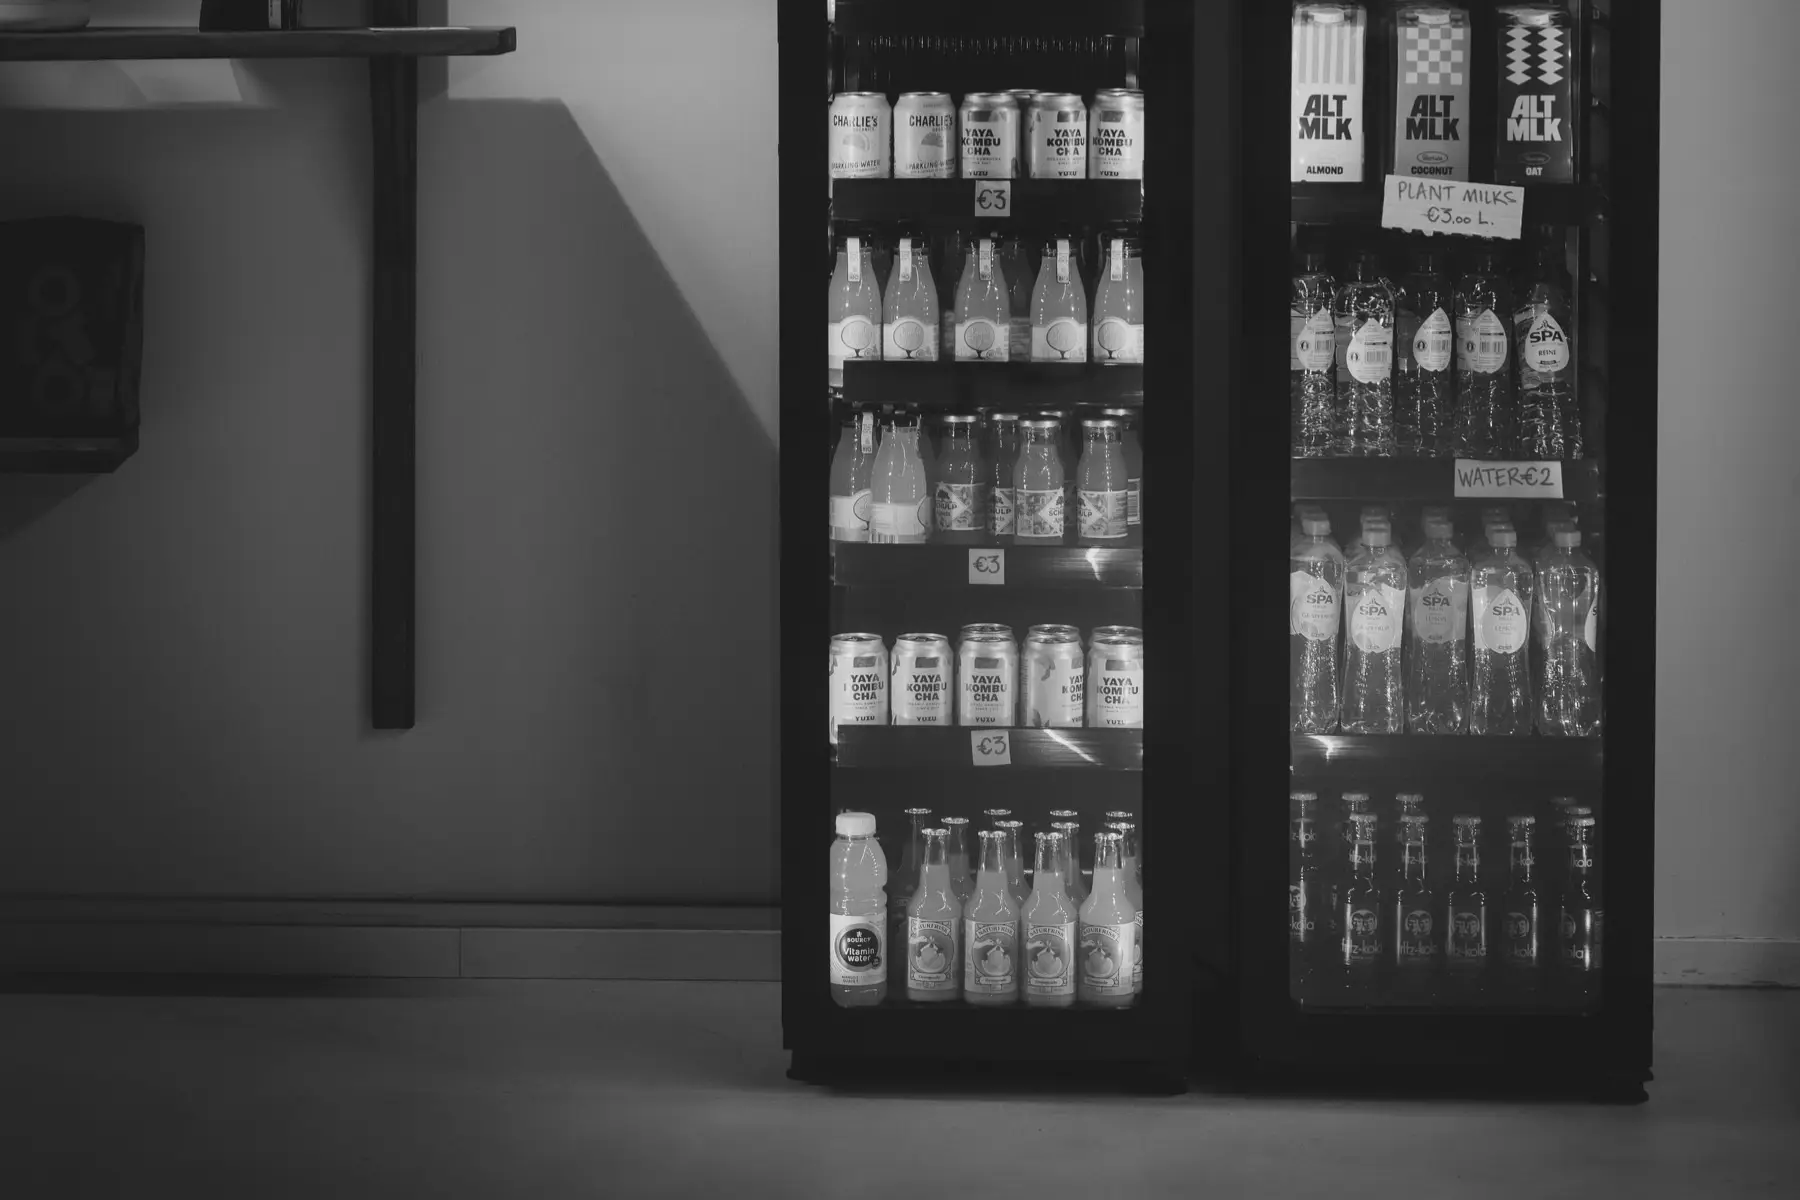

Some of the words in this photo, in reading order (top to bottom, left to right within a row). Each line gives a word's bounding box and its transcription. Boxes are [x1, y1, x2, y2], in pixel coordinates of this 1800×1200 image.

[1303, 94, 1347, 117] ALT
[1409, 94, 1454, 117] ALT
[1510, 94, 1556, 118] ALT
[965, 128, 994, 138] YAYA
[1053, 128, 1082, 138] YAYA
[1096, 128, 1125, 138] YAYA
[1299, 117, 1352, 140] MLK
[1405, 117, 1460, 141] MLK
[1506, 117, 1562, 142] MLK
[961, 138, 1001, 147] KOMBU
[1092, 138, 1133, 147] KOMBU
[967, 148, 991, 156] CHA
[1098, 148, 1123, 157] CHA
[1306, 165, 1344, 176] ALMOND
[1410, 165, 1454, 176] COCONUT
[1525, 167, 1543, 176] OAT
[1397, 180, 1457, 202] PLANT
[1462, 188, 1517, 207] MILKS
[976, 188, 1007, 211] €3
[1529, 330, 1563, 344] SPA
[1457, 468, 1522, 488] WATER
[972, 554, 1001, 573] €3
[1306, 594, 1333, 604] SPA
[1422, 595, 1450, 606] SPA
[1359, 605, 1388, 616] SPA
[1491, 605, 1520, 616] SPA
[851, 673, 880, 683] YAYA
[912, 674, 942, 683] YAYA
[971, 674, 1002, 683] YAYA
[1102, 677, 1133, 686] YAYA
[906, 682, 947, 692] KOMBU
[966, 682, 1007, 692] KOMBU
[853, 692, 878, 701] CHA
[914, 692, 939, 701] CHA
[974, 692, 999, 702] CHA
[977, 735, 1007, 757] €3
[844, 947, 875, 956] Vitamin
[847, 954, 871, 962] water
